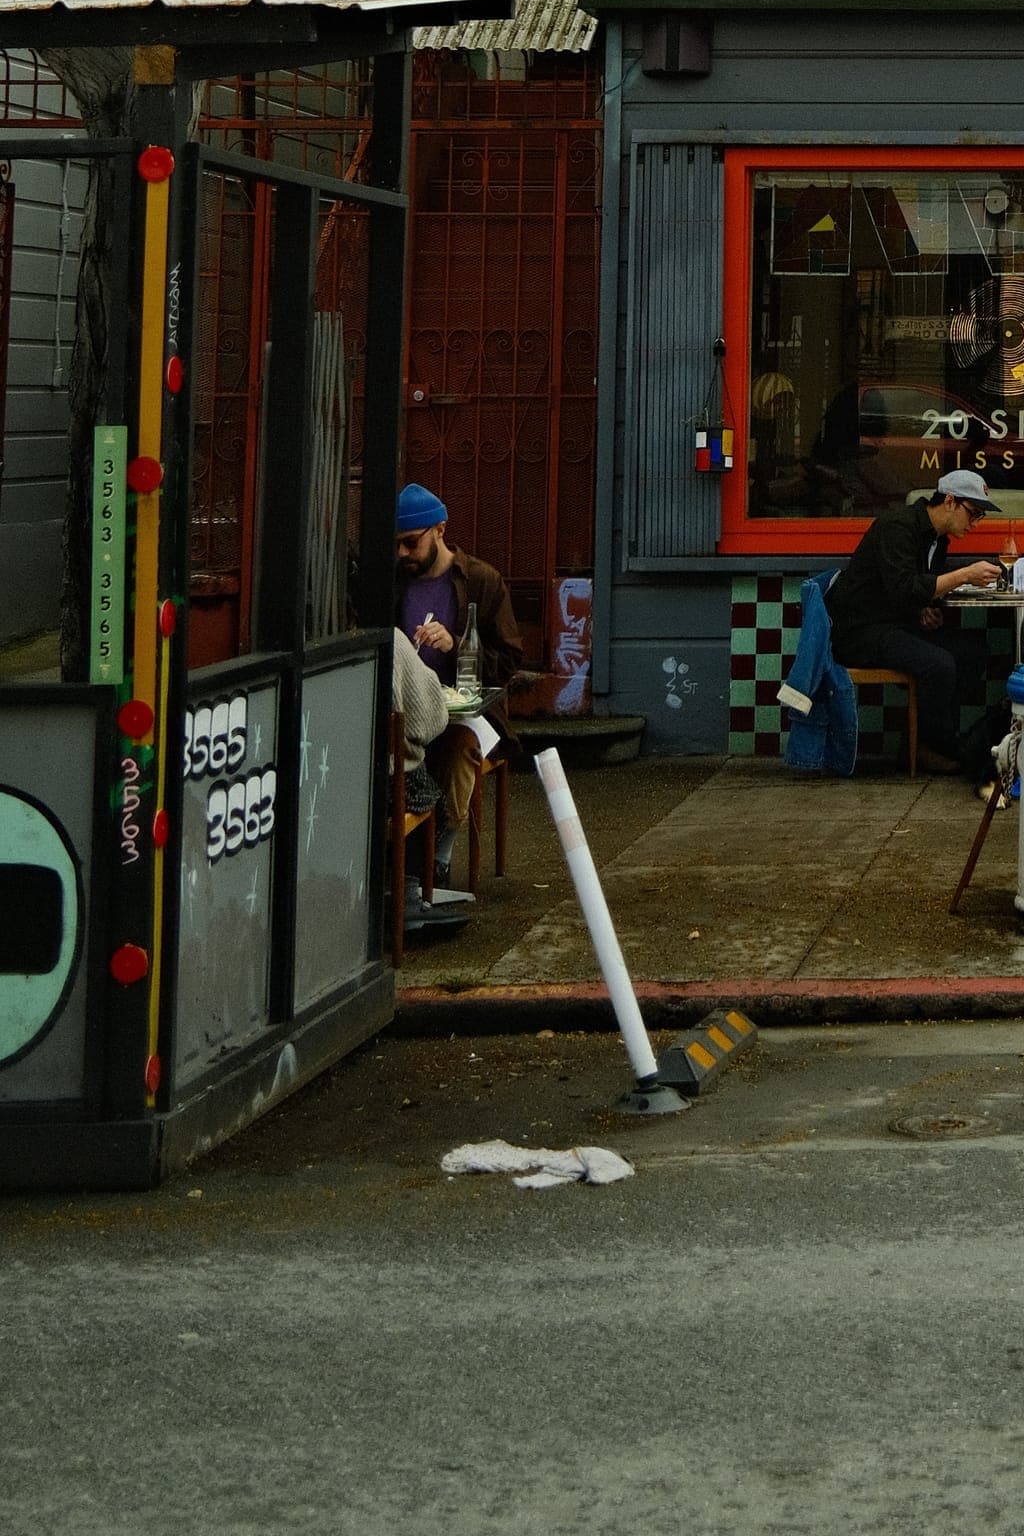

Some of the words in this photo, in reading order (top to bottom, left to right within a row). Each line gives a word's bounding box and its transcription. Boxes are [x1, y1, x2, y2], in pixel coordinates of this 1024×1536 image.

[922, 410, 967, 439] 20
[102, 460, 115, 543] 3563
[99, 574, 112, 657] 3565
[121, 758, 141, 865] 3563
[207, 770, 276, 858] 3563
